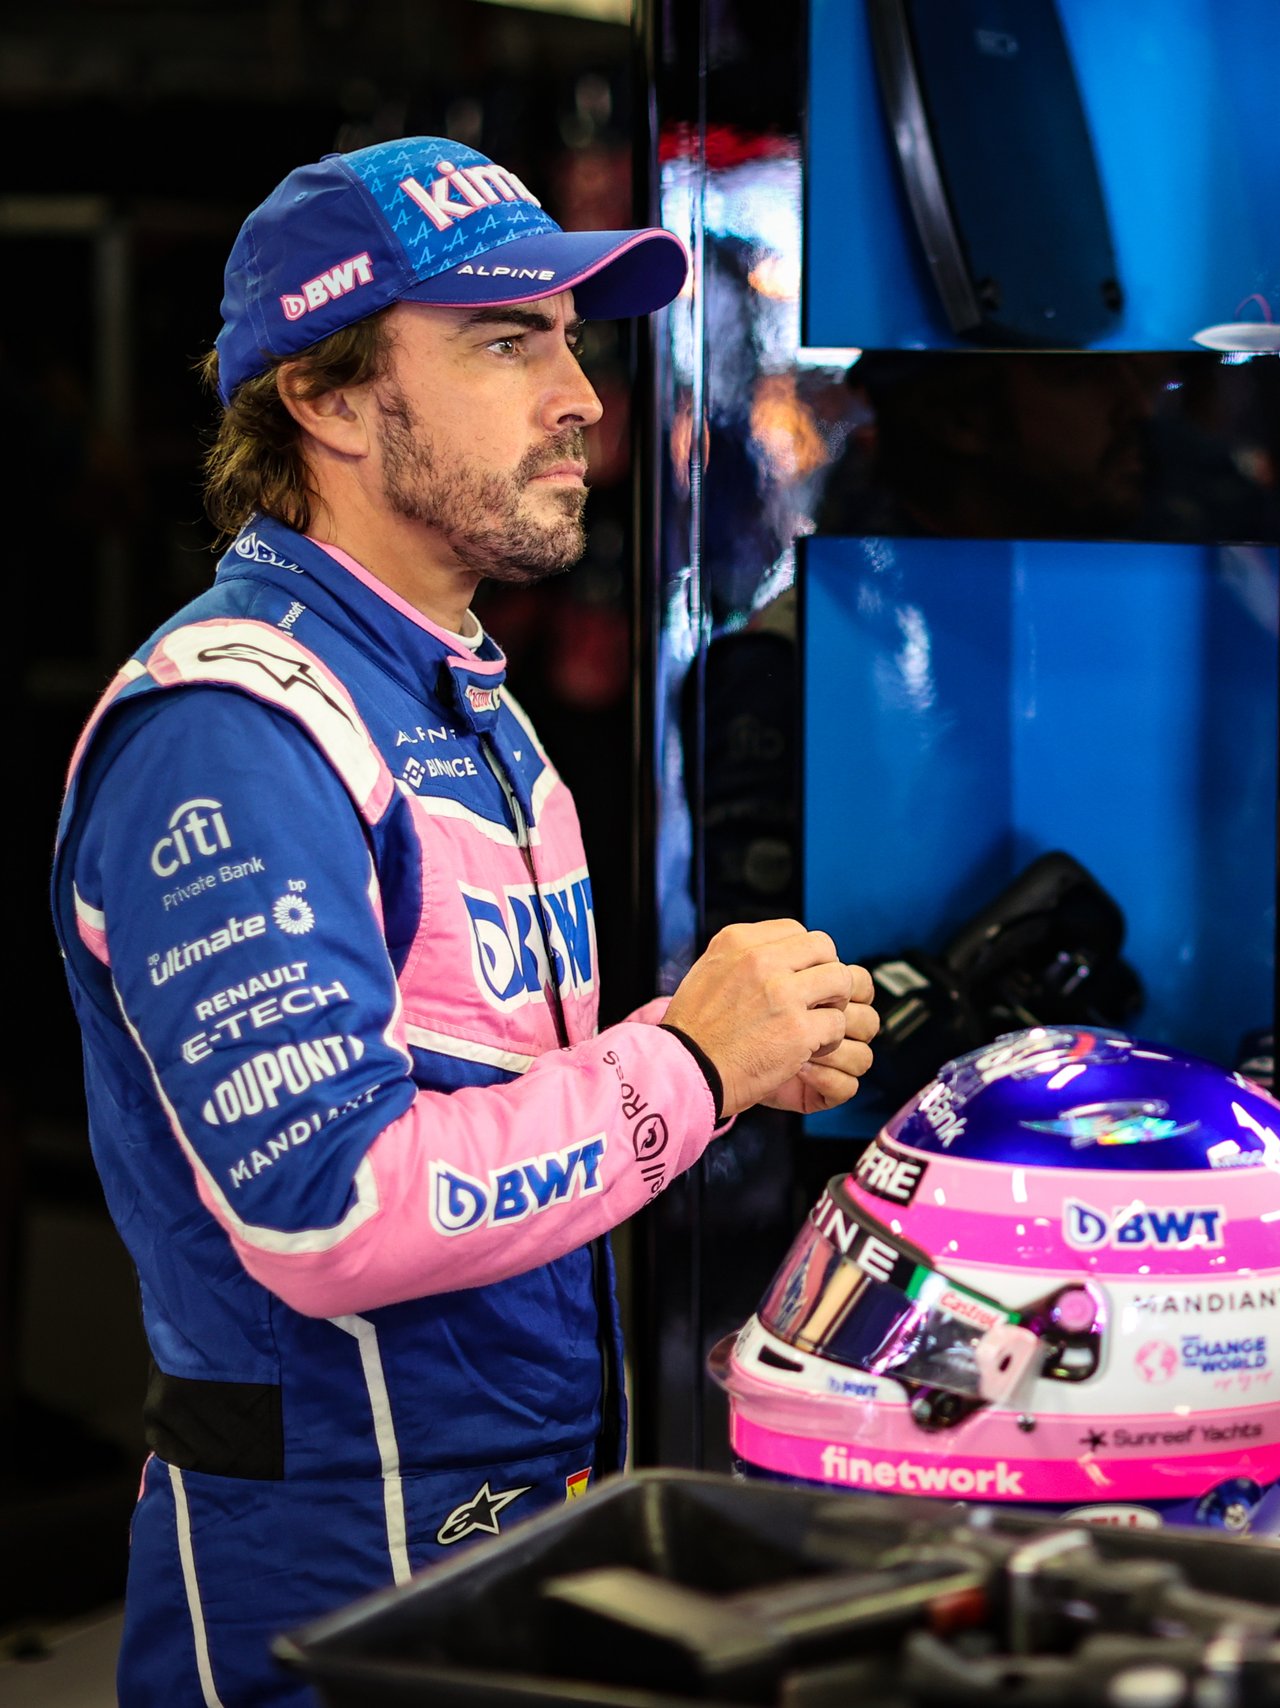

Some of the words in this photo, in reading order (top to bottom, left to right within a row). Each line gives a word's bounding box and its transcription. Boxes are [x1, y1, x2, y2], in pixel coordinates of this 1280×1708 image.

[400, 161, 542, 232] kim
[302, 252, 373, 311] BWT
[457, 264, 556, 281] ALPINE
[151, 803, 232, 877] citi
[163, 875, 216, 911] Private
[219, 857, 265, 882] Bank
[288, 879, 307, 893] bp
[151, 914, 267, 986] ultimate
[196, 962, 309, 1022] RENAULT
[182, 981, 350, 1065] E-TECH
[213, 1035, 351, 1125] DUPONT
[493, 1138, 606, 1222] BWT
[1114, 1209, 1219, 1244] BWT
[1182, 1336, 1267, 1359] CHANGE
[1201, 1354, 1267, 1373] WORLD
[1113, 1425, 1197, 1447] Sunreef
[1202, 1423, 1264, 1442] Yachts
[820, 1445, 1025, 1495] finetwork
